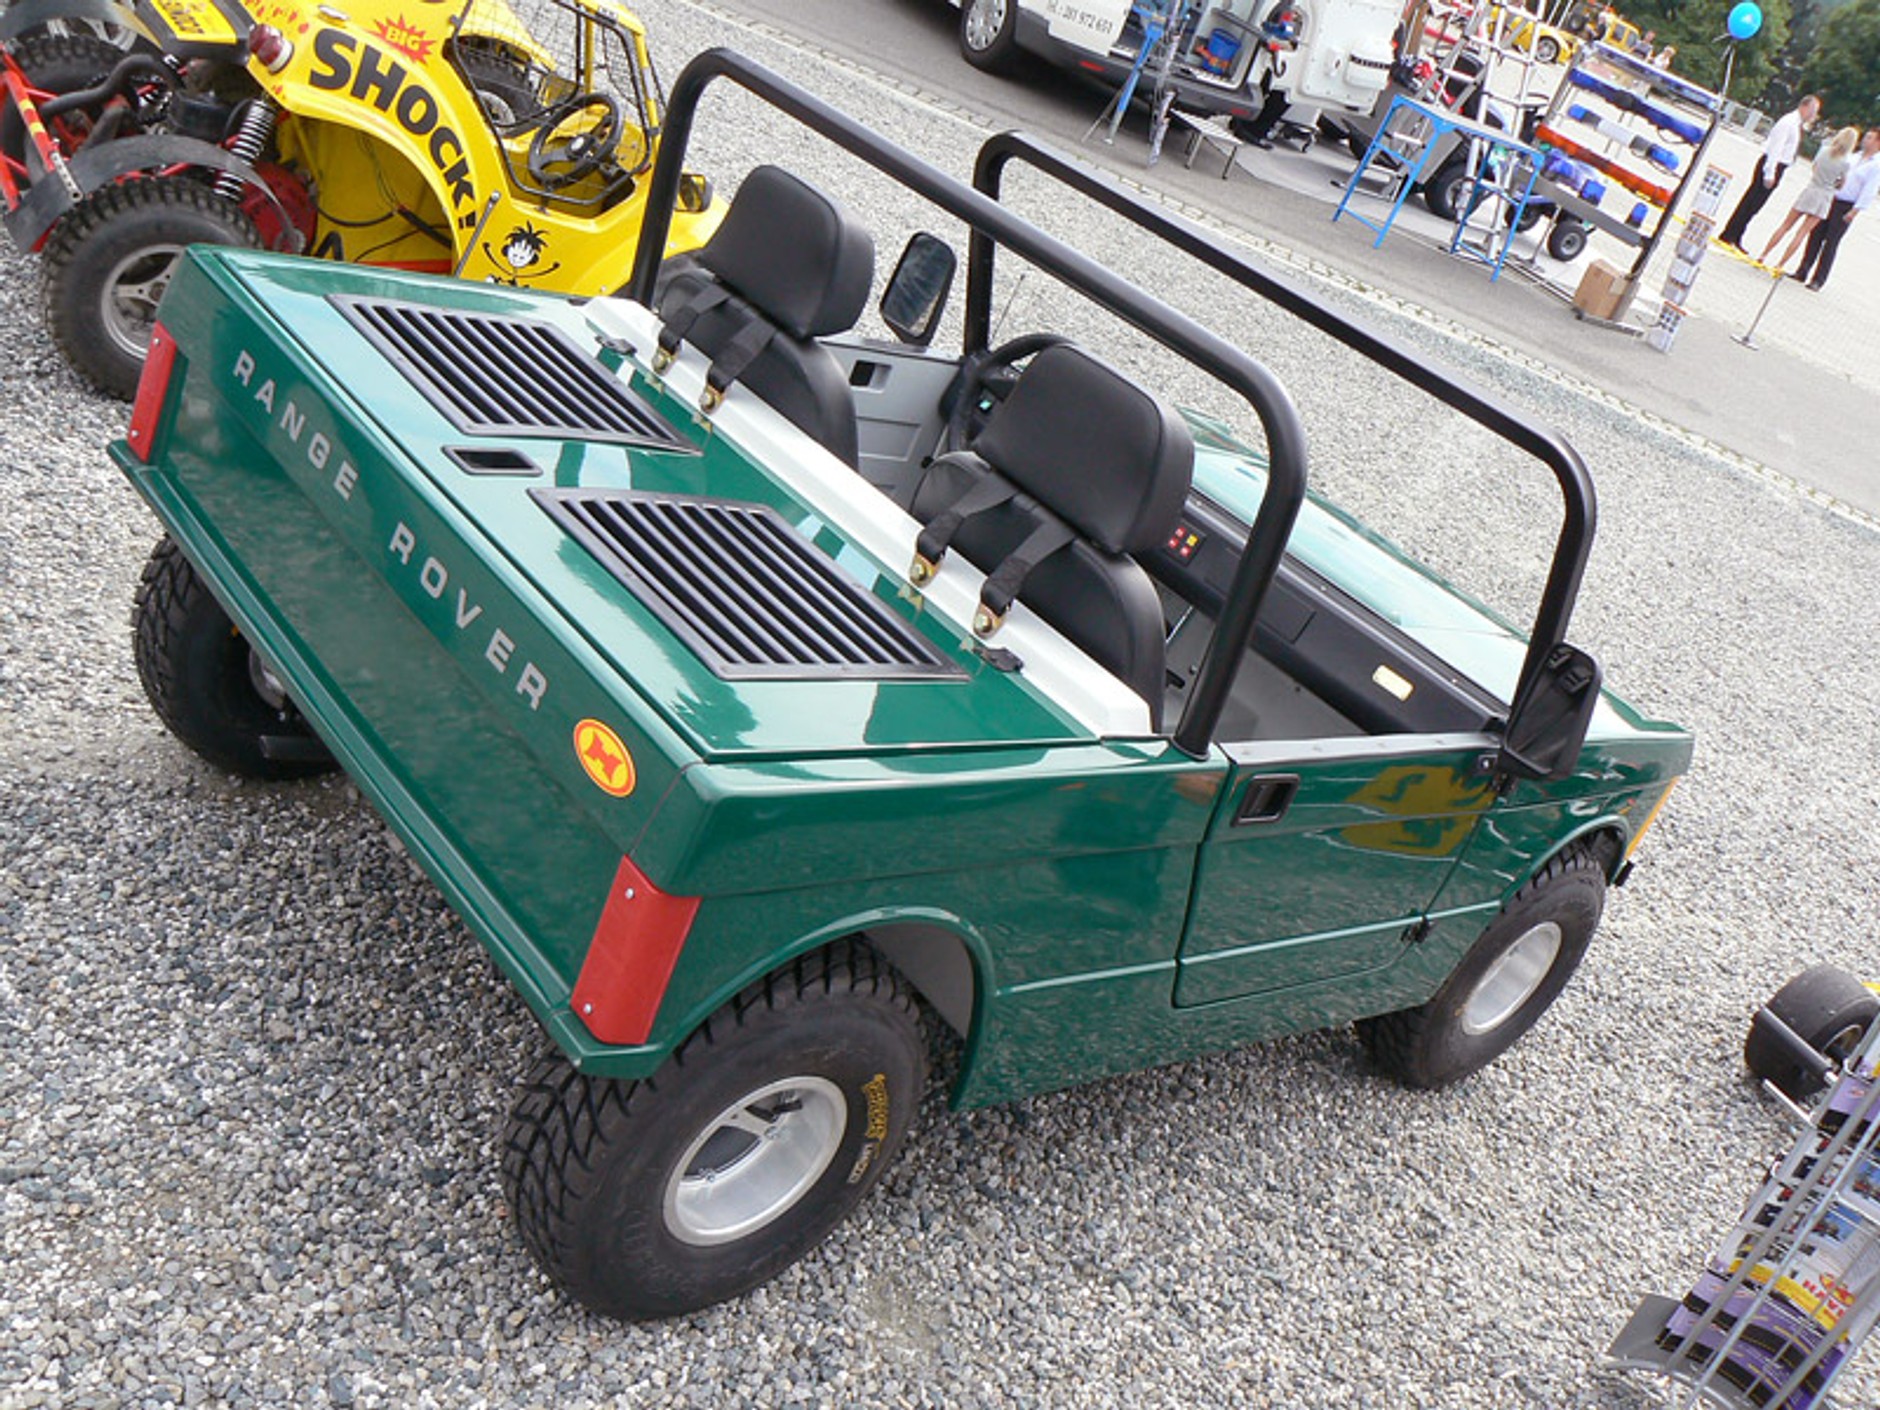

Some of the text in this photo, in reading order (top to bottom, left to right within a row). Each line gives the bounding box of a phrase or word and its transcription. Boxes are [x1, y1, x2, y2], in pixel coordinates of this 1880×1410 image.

[308, 27, 476, 230] SHOCK!
[385, 27, 421, 50] BIG
[233, 350, 548, 712] RANGE ROVER
